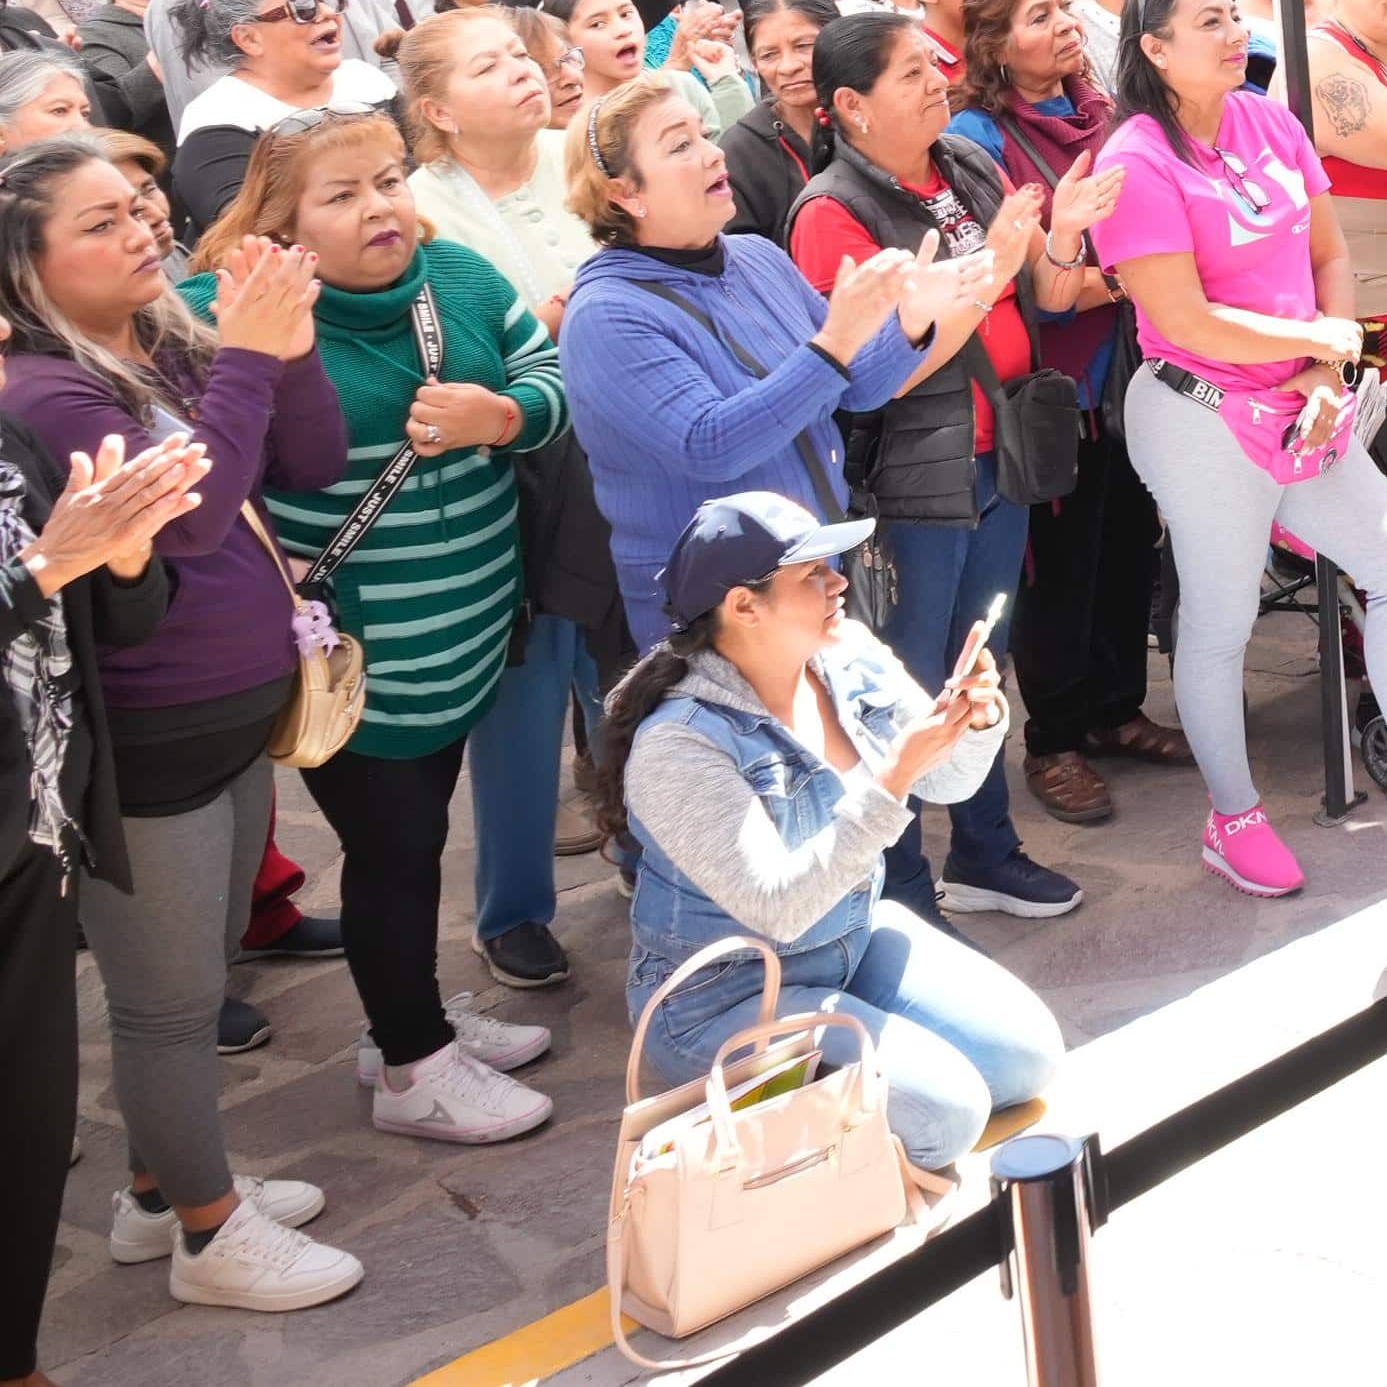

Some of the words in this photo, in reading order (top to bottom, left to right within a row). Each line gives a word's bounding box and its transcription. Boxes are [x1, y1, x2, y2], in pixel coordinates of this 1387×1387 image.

[384, 449, 413, 484] SMILE
[358, 492, 383, 524] JUST
[331, 521, 361, 556] SMILE
